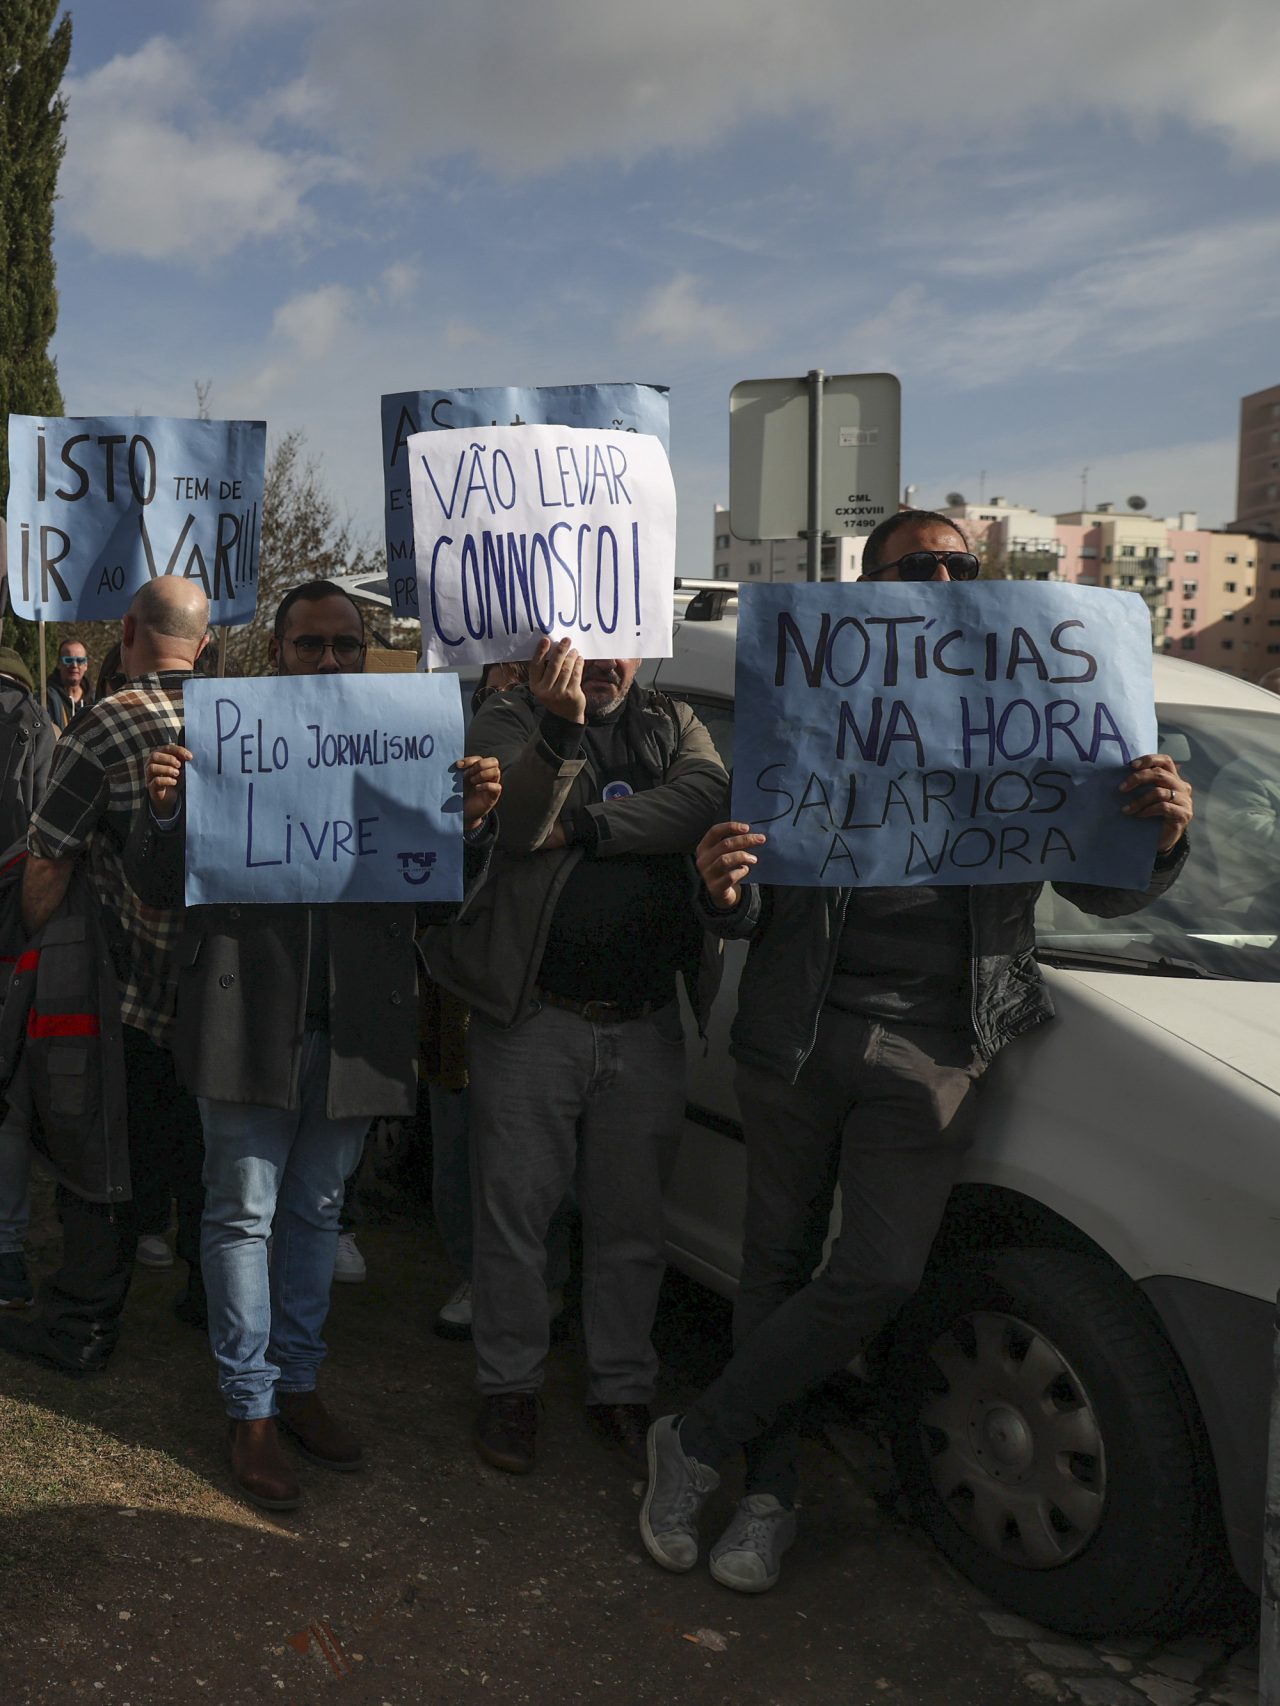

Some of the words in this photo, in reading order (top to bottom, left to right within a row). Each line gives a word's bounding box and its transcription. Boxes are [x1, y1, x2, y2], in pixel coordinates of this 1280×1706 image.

[37, 426, 156, 506] ISTO
[173, 477, 209, 500] TEM
[220, 480, 242, 500] DE
[421, 442, 516, 519] VÃO
[535, 445, 632, 507] LEVAR
[848, 494, 871, 502] CML
[20, 523, 72, 602] IR
[97, 566, 125, 595] AO
[430, 521, 641, 646] CONNOSCO!
[774, 611, 1099, 689] NOTÍCIAS
[215, 698, 288, 775] PELO
[307, 725, 434, 769] JORNALISMO
[835, 696, 925, 767] NA
[959, 696, 1131, 768] HORA
[246, 782, 380, 868] LIVRE
[751, 763, 1071, 830] SALÁRIOS
[397, 851, 436, 868] TSF
[905, 826, 1077, 875] NORA
